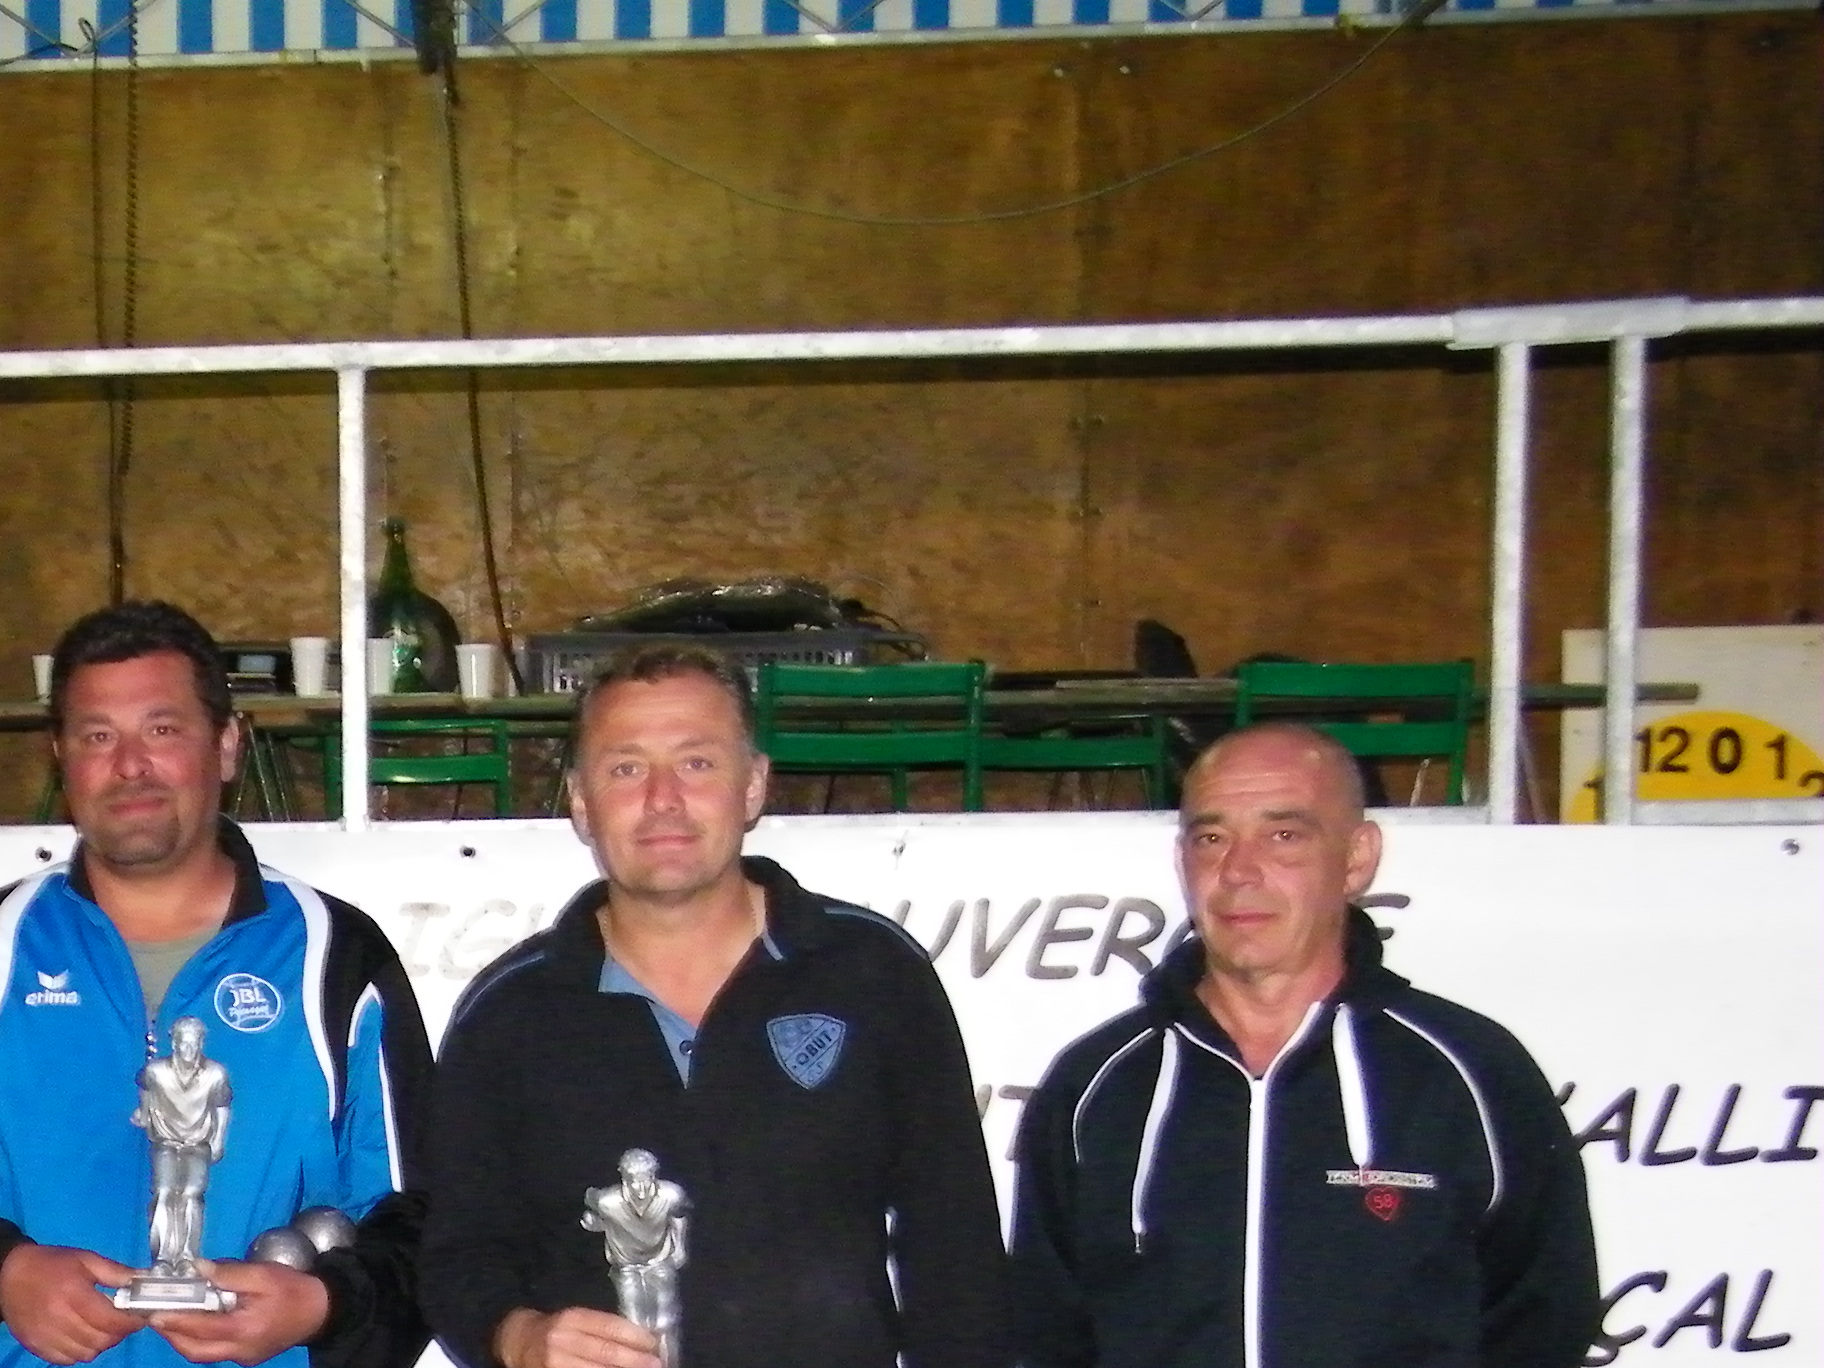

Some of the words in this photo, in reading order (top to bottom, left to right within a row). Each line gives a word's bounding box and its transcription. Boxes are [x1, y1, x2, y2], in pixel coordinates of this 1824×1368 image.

[1634, 727, 1691, 773] 12
[1707, 727, 1744, 774] 0
[1764, 734, 1789, 781] 1
[24, 989, 82, 1007] erima
[229, 986, 267, 1008] JBL
[1555, 1081, 1824, 1167] ALLI
